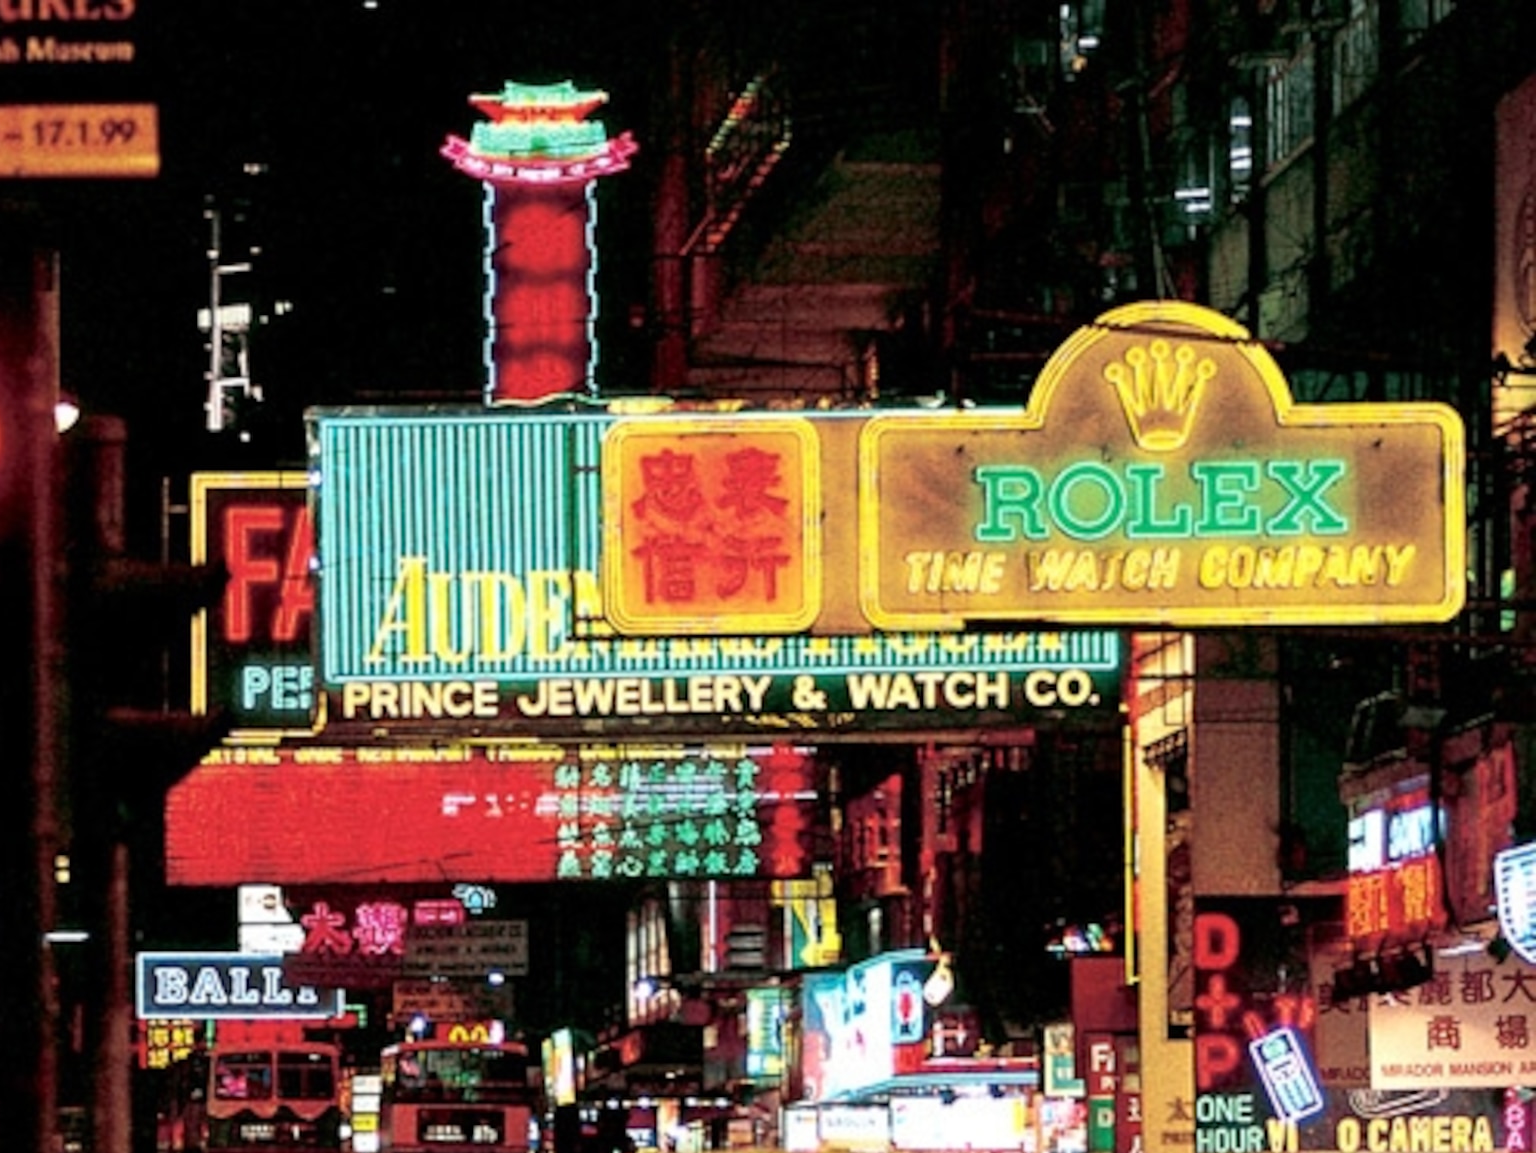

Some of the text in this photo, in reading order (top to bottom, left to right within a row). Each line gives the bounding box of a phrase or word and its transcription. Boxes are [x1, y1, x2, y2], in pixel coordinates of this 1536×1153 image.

[26, 37, 135, 62] Museum
[33, 119, 139, 147] 17.1.99
[975, 459, 1349, 542] ROLEX
[905, 544, 1416, 594] TIME WATCH COMPANY
[343, 668, 1101, 719] PRINCE JEWELLERY & WATCH CO.
[1449, 1060, 1512, 1077] MANSION
[1196, 1094, 1253, 1123] ONE
[1366, 1116, 1494, 1153] CAMERA
